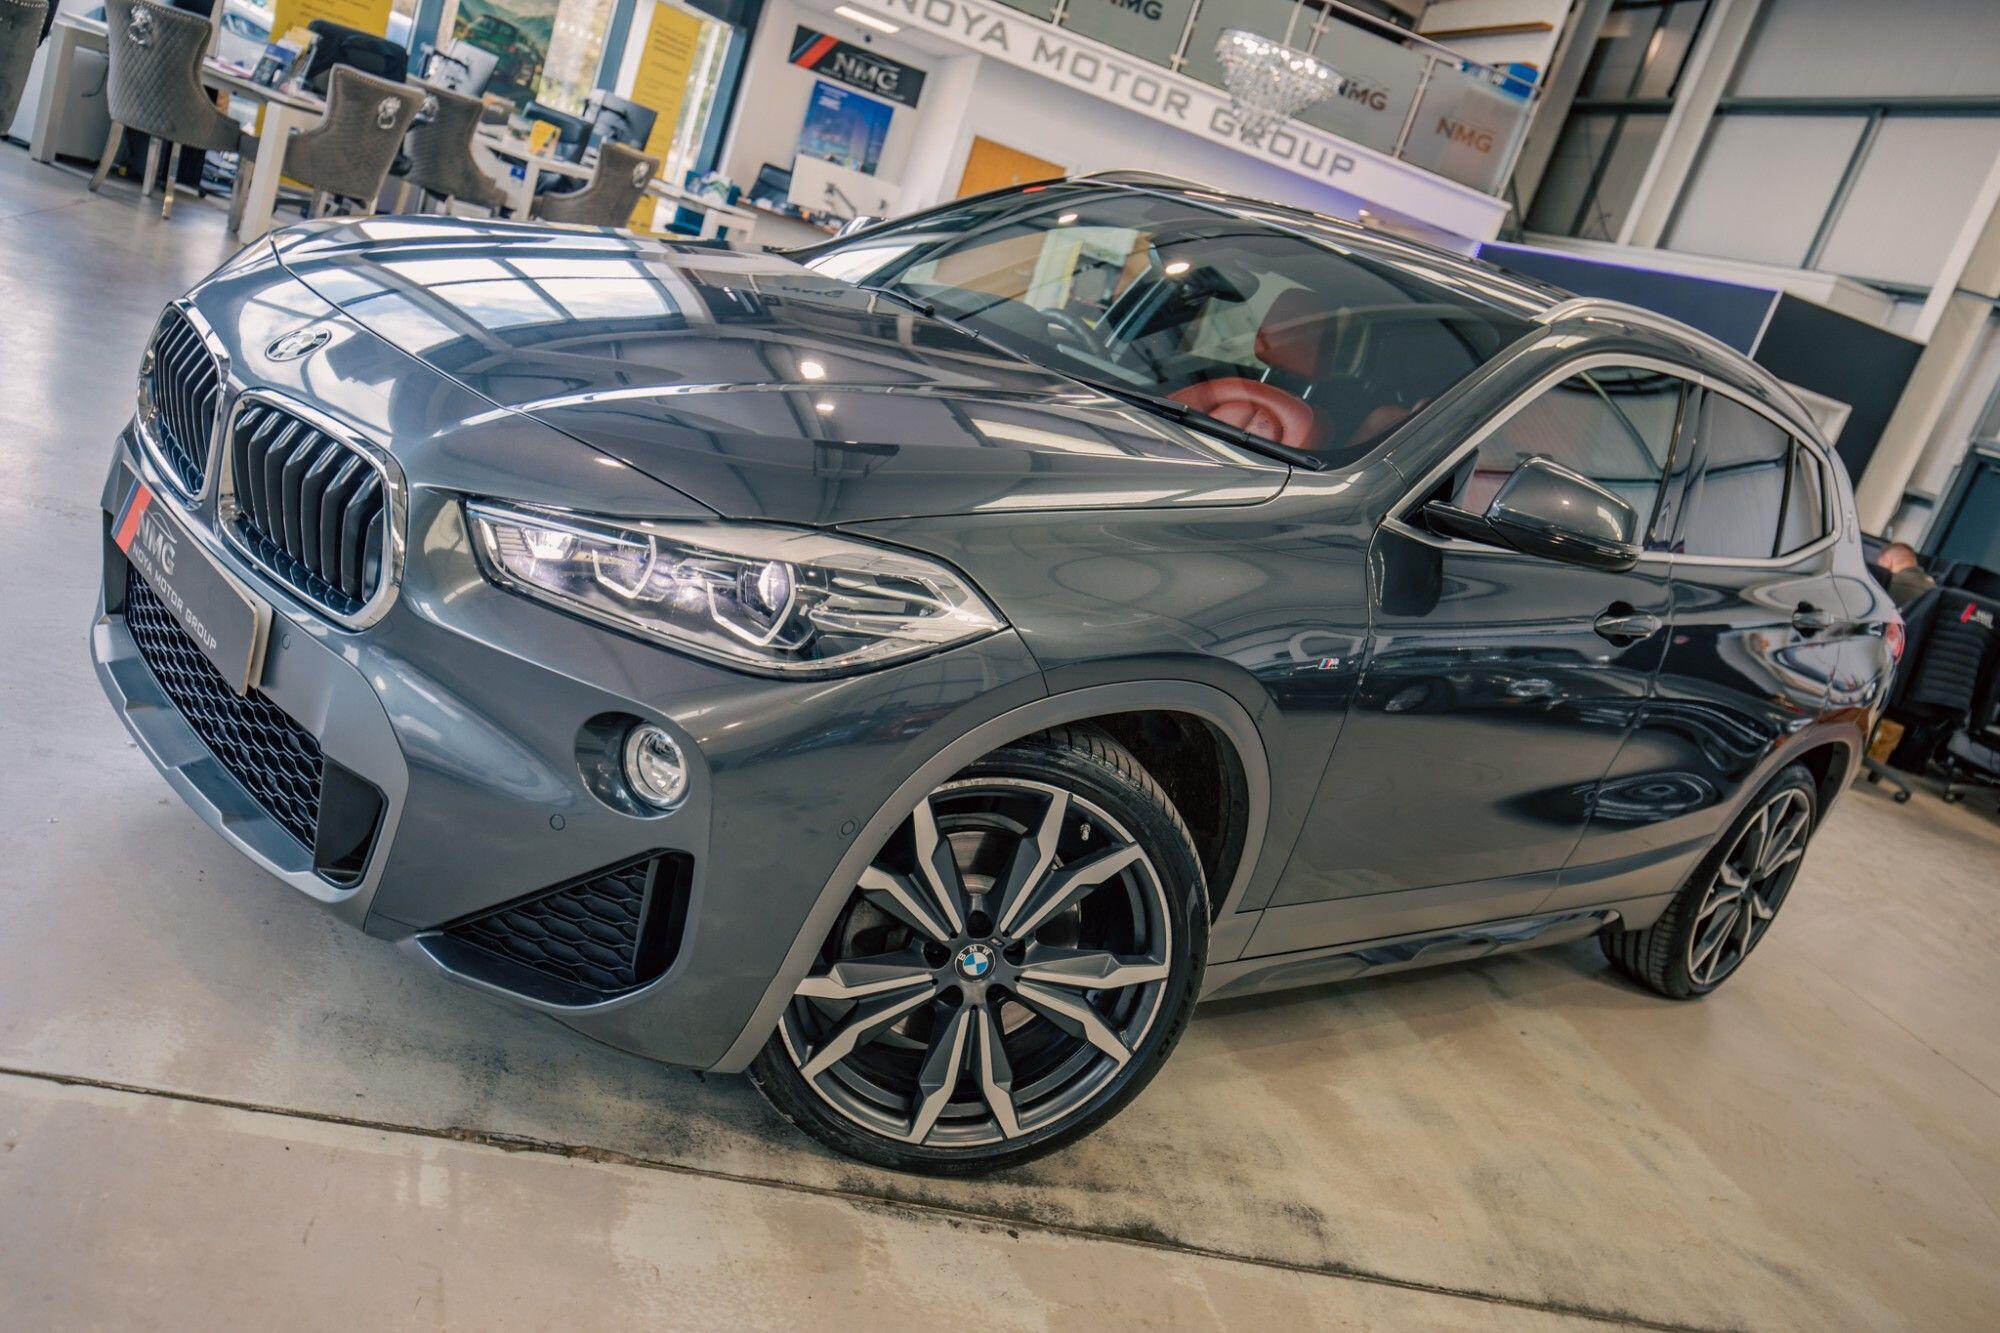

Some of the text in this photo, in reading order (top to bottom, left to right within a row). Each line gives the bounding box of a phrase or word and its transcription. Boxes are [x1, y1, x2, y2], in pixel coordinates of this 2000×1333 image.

[833, 52, 899, 91] NMG
[1032, 36, 1192, 120] MOTOR
[1210, 106, 1355, 176] GROUP
[1435, 116, 1493, 152] NMG
[136, 508, 176, 576] NMG
[132, 541, 217, 650] NOYA MOTOR GROUP
[958, 945, 992, 961] BMW
